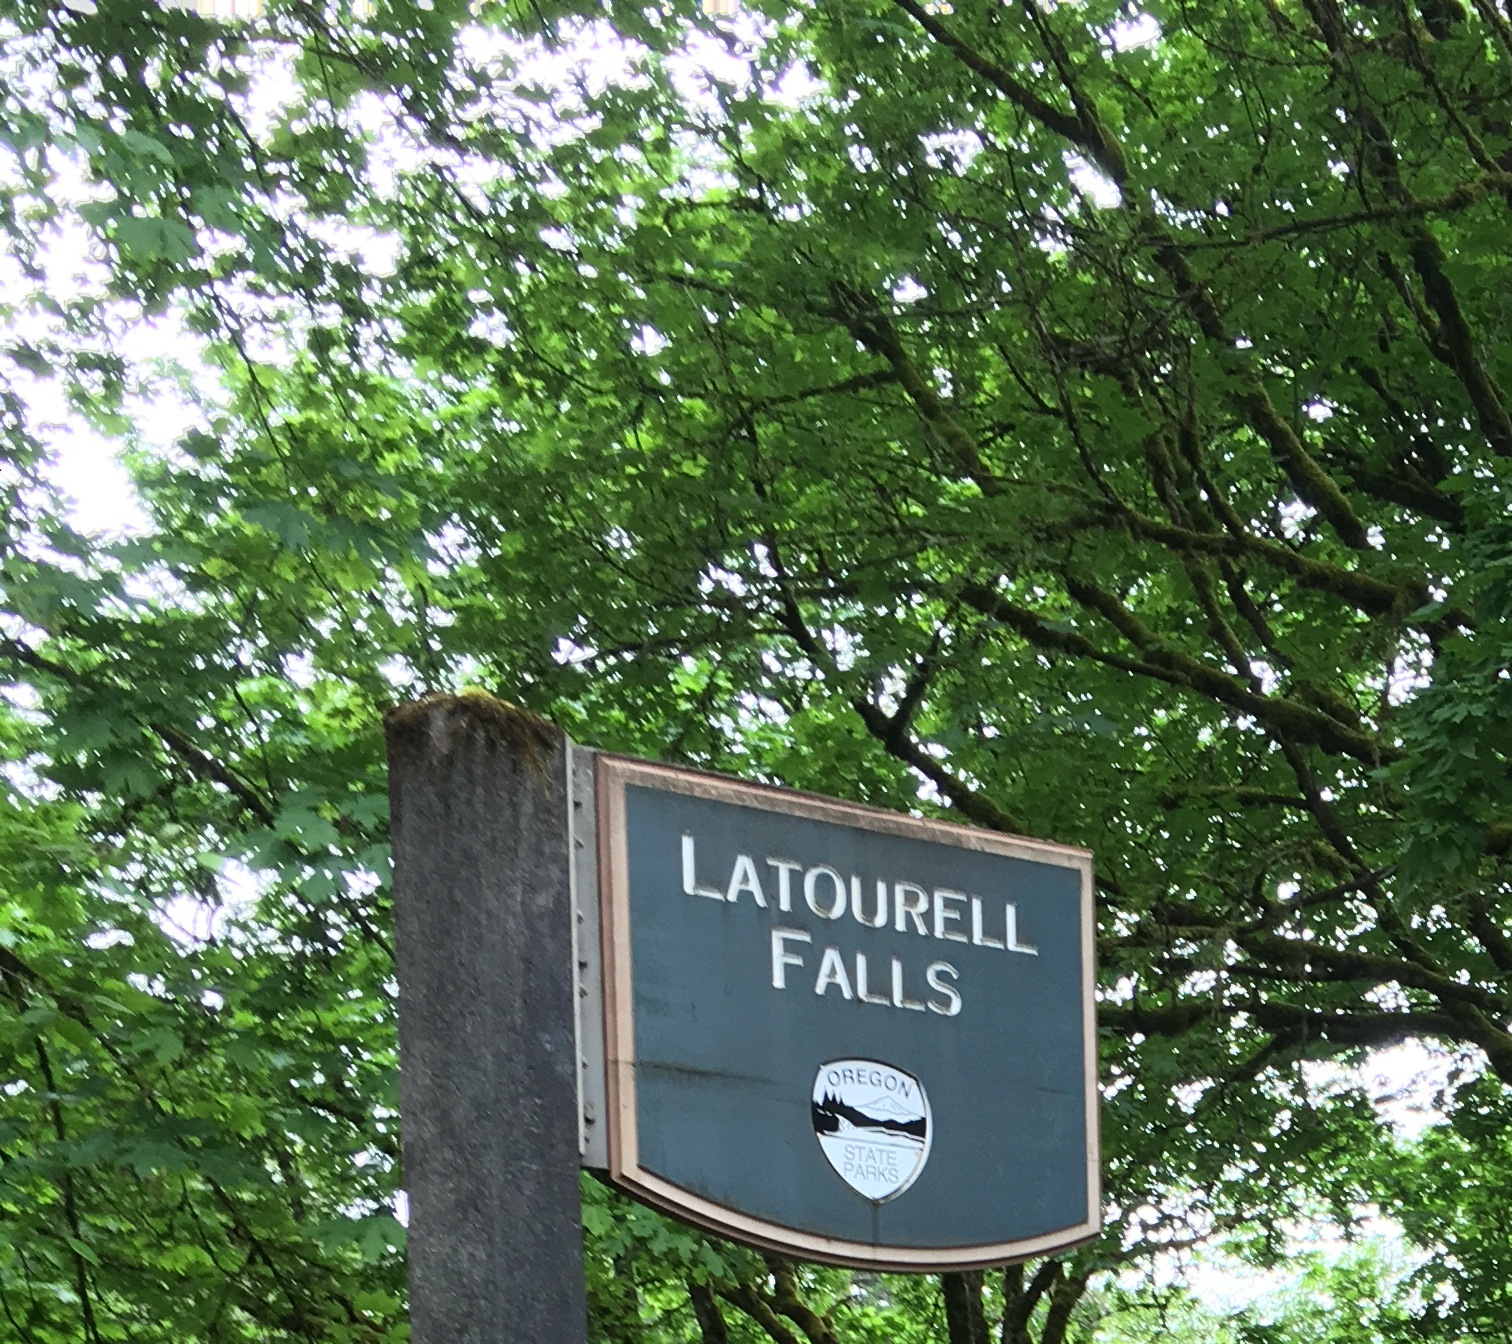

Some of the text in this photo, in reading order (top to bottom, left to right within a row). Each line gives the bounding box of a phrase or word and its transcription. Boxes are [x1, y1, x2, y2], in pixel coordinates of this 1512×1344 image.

[681, 831, 1039, 956] LATOURELL
[771, 928, 962, 1017] FALLS
[827, 1068, 913, 1099] OREGON
[844, 1144, 898, 1167] STATE
[843, 1161, 900, 1184] PARKS
